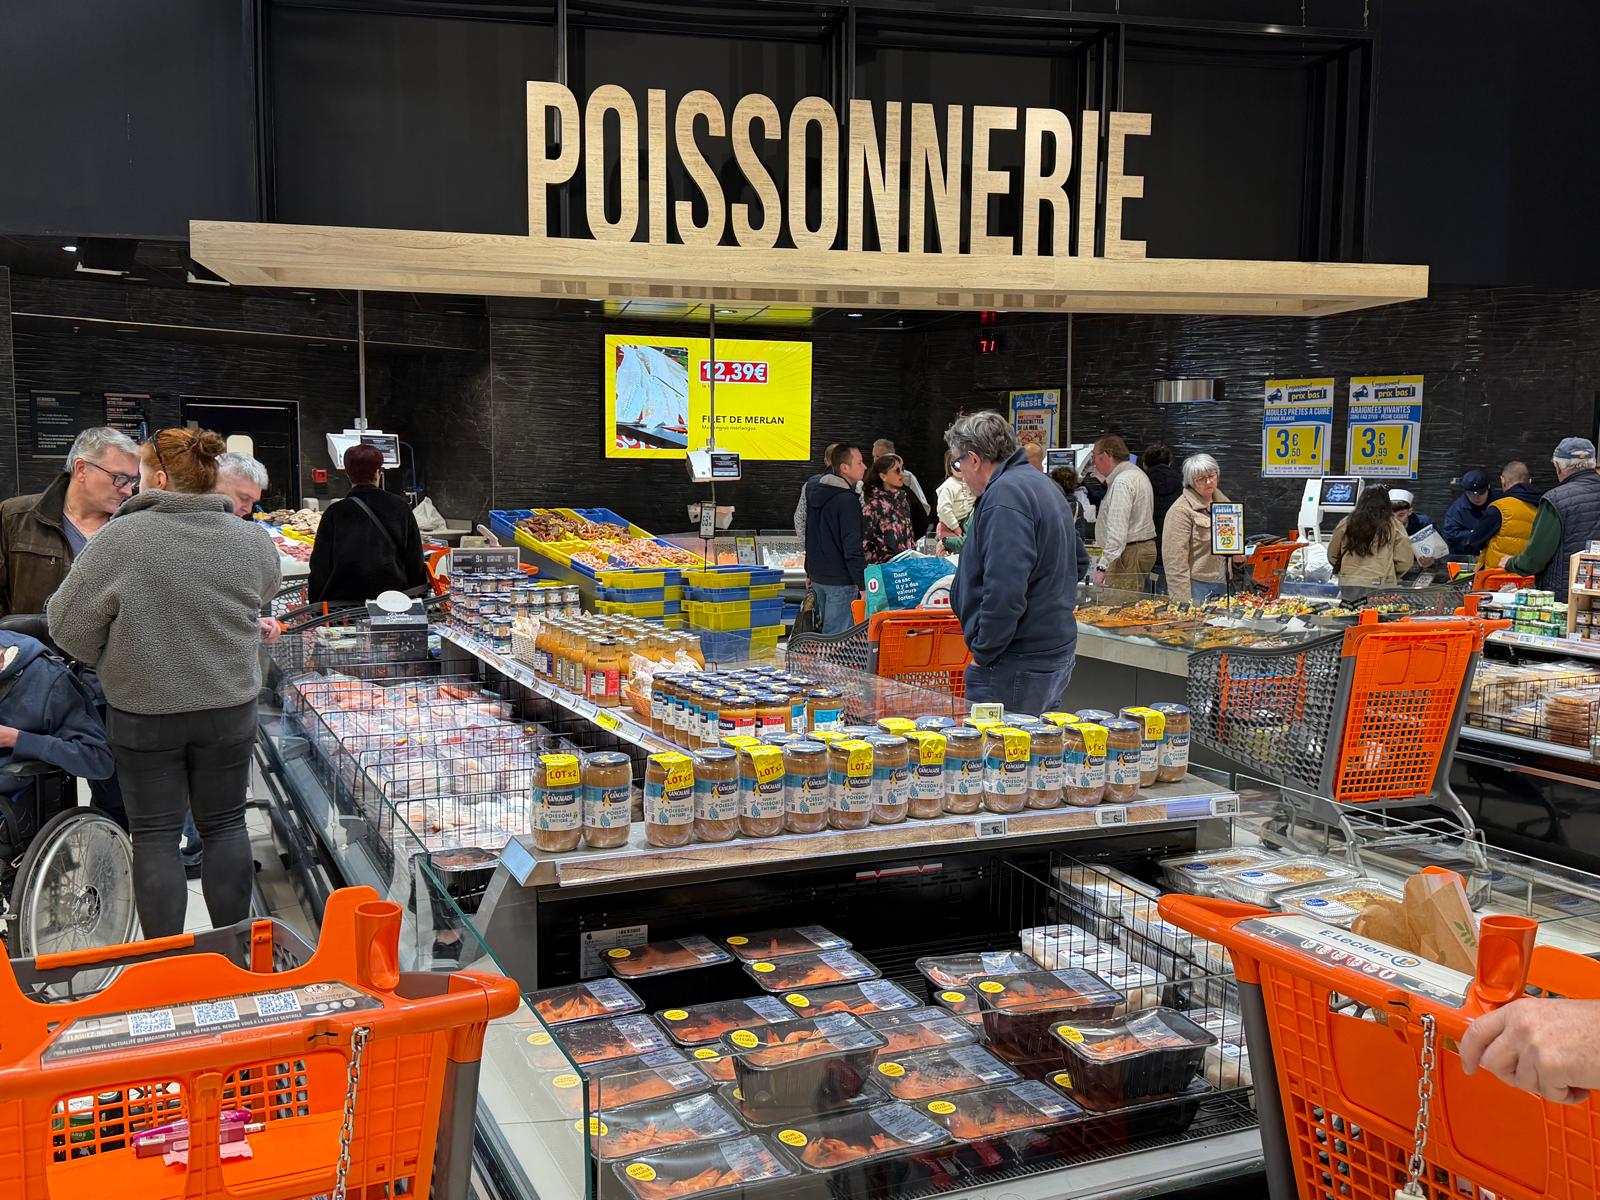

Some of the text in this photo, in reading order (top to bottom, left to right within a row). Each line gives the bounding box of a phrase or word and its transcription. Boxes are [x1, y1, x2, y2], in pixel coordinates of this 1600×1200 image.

[527, 80, 1152, 258] POISSONNERIE
[703, 362, 766, 382] 12,39€
[1292, 390, 1305, 404] prix
[1307, 389, 1320, 399] bas
[1378, 388, 1392, 401] prix
[1395, 386, 1409, 396] bas
[1016, 399, 1042, 408] PRESSE
[1266, 408, 1287, 416] MOULES
[1314, 407, 1330, 415] CUIRE
[1382, 405, 1411, 413] VIVANTES
[702, 415, 785, 425] FIET DE MERLAN
[1276, 429, 1290, 458] 3
[1361, 428, 1376, 457] 3
[869, 581, 877, 590] U
[922, 751, 934, 759] LO
[1008, 748, 1019, 757] LO
[759, 766, 775, 777] LOT
[850, 763, 865, 771] LOT
[549, 770, 577, 780] LOT x2
[667, 775, 683, 785] LOT
[1319, 930, 1393, 959] E.Leclerc
[144, 1034, 166, 1043] MAGASIN
